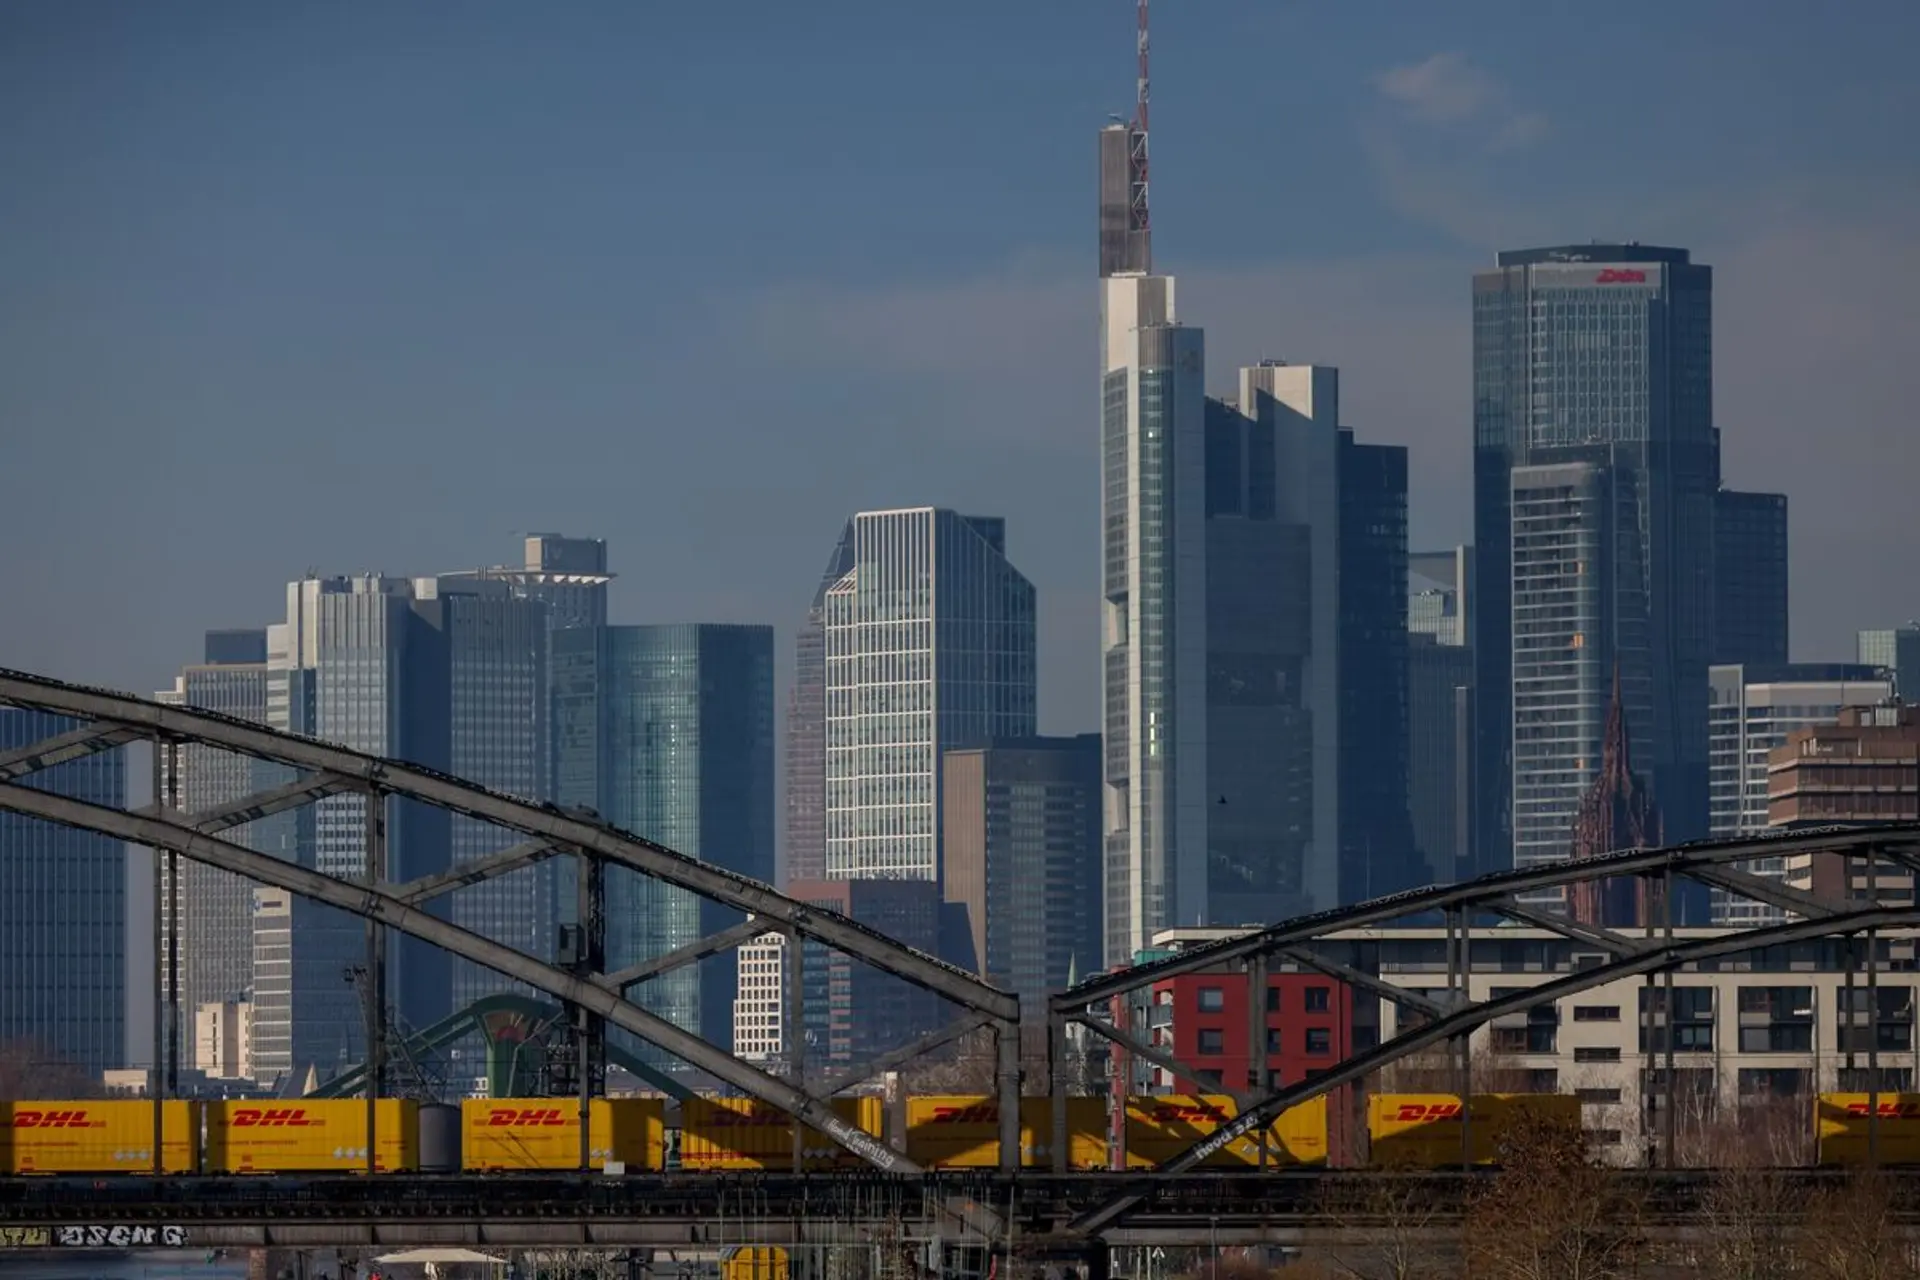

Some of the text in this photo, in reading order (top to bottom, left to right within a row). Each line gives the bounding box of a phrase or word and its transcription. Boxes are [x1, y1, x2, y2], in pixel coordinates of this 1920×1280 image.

[14, 1111, 90, 1128] DHL
[233, 1109, 309, 1126] DHL
[488, 1109, 565, 1126] DHL
[1152, 1106, 1231, 1122] DHL
